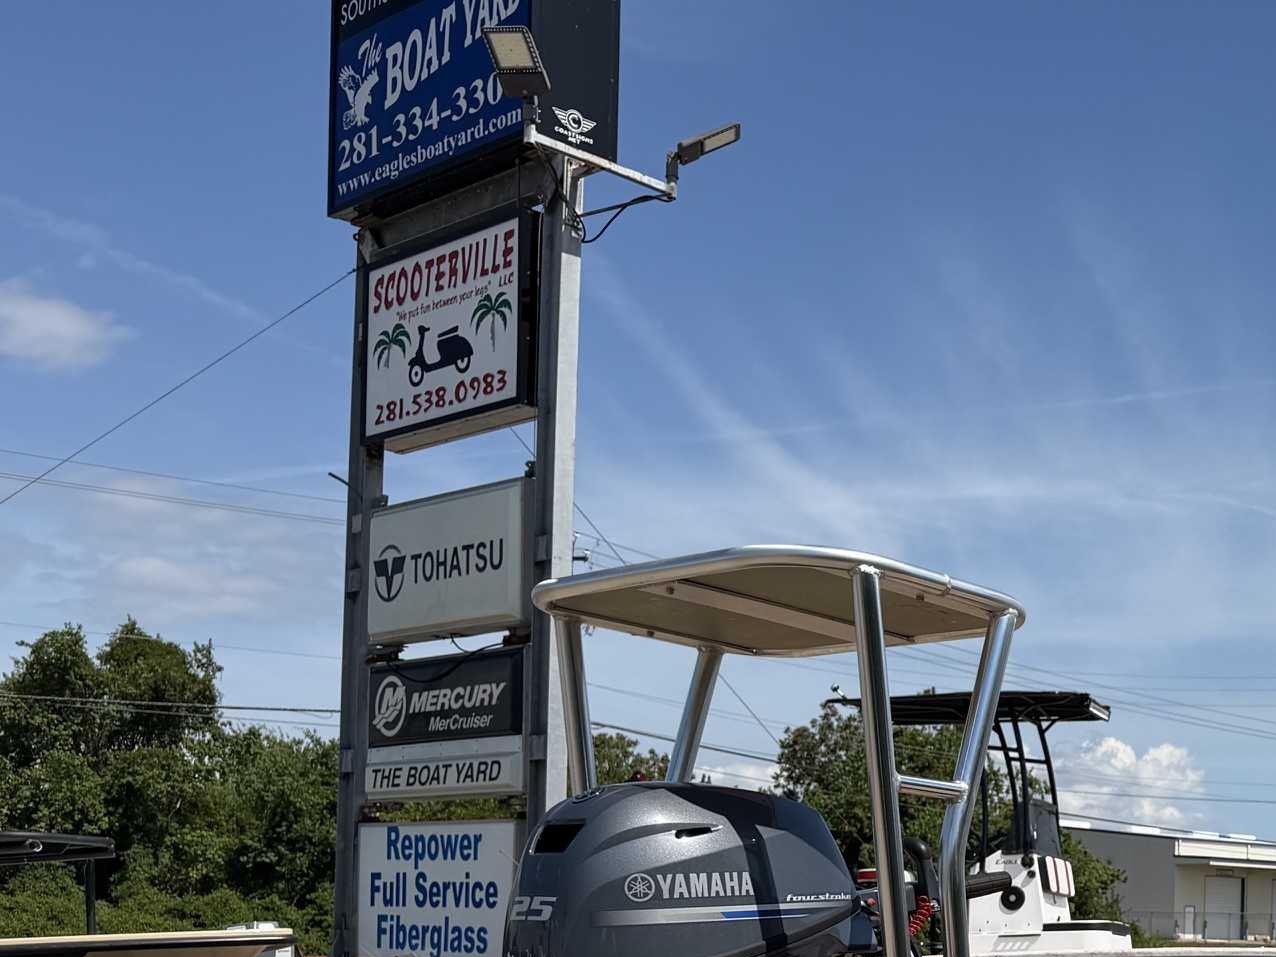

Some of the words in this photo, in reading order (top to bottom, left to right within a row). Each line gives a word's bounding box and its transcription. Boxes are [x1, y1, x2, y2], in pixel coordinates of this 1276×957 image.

[358, 32, 383, 78] The
[384, 4, 456, 110] BOAT
[337, 71, 503, 172] 281-334-330
[337, 107, 522, 197] www.eaglesboatyard.com
[373, 228, 515, 314] SCOOTERVILLE
[498, 271, 514, 288] LLC
[432, 294, 458, 311] between
[458, 288, 473, 304] your
[374, 369, 507, 426] 281.538.0983
[410, 538, 503, 585] TOHATSU
[409, 682, 507, 714] MERCURY
[428, 712, 493, 732] MerCruiser
[372, 767, 403, 789] THE
[406, 764, 453, 787] BOAT
[455, 760, 501, 784] YARD
[386, 825, 482, 870] Repower
[370, 872, 407, 908] Full
[414, 871, 498, 909] Service
[656, 870, 755, 899] YAMAHA
[510, 896, 556, 921] 25
